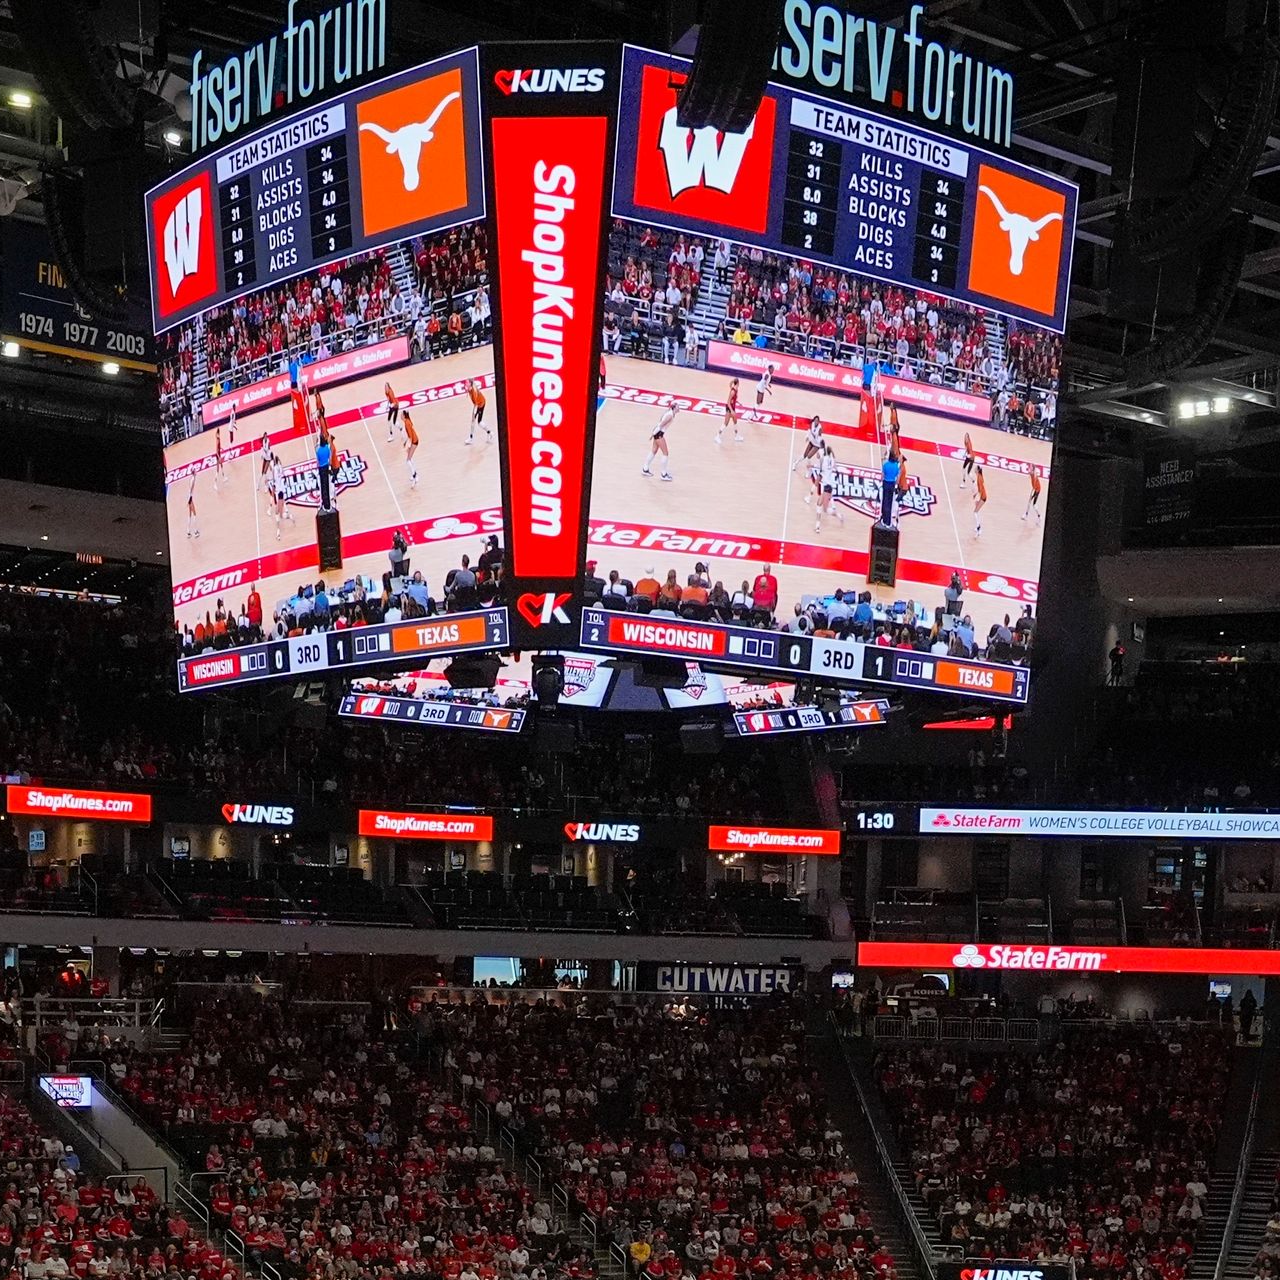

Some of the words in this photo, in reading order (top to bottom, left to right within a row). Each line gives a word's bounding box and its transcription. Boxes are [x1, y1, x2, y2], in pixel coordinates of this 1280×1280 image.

[511, 68, 606, 94] KUNES
[228, 146, 260, 175] TEAM
[261, 112, 330, 160] STATISTICS
[813, 107, 862, 140] TEAM
[864, 123, 952, 168] STATISTICS
[261, 158, 294, 187] KILLS
[320, 145, 333, 161] 34
[808, 141, 825, 158] 32
[860, 152, 904, 181] KILLS
[936, 179, 950, 196] 34
[229, 184, 240, 201] 32
[256, 177, 303, 211] ASSISTS
[322, 168, 334, 185] 34
[806, 164, 822, 181] 31
[848, 173, 912, 207] ASSISTS
[934, 202, 948, 218] 34
[231, 206, 241, 223] 31
[259, 200, 303, 232] BLOCKS
[802, 186, 822, 204] 8.0
[848, 196, 907, 228] BLOCKS
[930, 223, 947, 240] 4.0
[268, 226, 295, 252] DIGS
[324, 213, 337, 230] 34
[803, 210, 817, 226] 38
[858, 222, 894, 247] DIGS
[930, 245, 943, 261] 34
[269, 246, 298, 274] ACES
[328, 238, 336, 252] 3
[804, 233, 813, 250] 2
[854, 244, 895, 271] ACES
[930, 268, 939, 283] 3
[236, 271, 244, 286] 2
[19, 311, 54, 338] 1974
[62, 320, 99, 347] 1977
[105, 330, 146, 356] 2003
[520, 159, 576, 537] ShopKunes.com
[588, 612, 604, 624] TOL
[493, 630, 501, 642] 2
[192, 658, 234, 682] WISCONSIN
[275, 650, 283, 669] 0
[297, 643, 321, 665] 3RD
[336, 640, 345, 661] 1
[416, 623, 460, 647] TEXAS
[590, 628, 600, 642] 2
[622, 622, 715, 651] WISCONSIN
[789, 644, 801, 665] 0
[822, 649, 855, 671] 3RD
[874, 656, 884, 677] 1
[958, 667, 994, 689] TEXAS
[1016, 685, 1024, 698] 2
[423, 707, 446, 721] 3RD
[801, 713, 821, 726] 3RD
[26, 790, 133, 814] ShopKunes.com
[231, 803, 294, 826] KUNES
[374, 814, 475, 834] ShopKunes.com
[576, 822, 640, 842] KUNES
[856, 811, 895, 830] 1:30
[1028, 815, 1088, 830] WOMEN'S
[1089, 816, 1146, 832] COLLEGE
[1146, 817, 1223, 833] VOLLEYBALL
[725, 829, 824, 849] ShopKunes.com
[656, 965, 792, 996] CUTWATER
